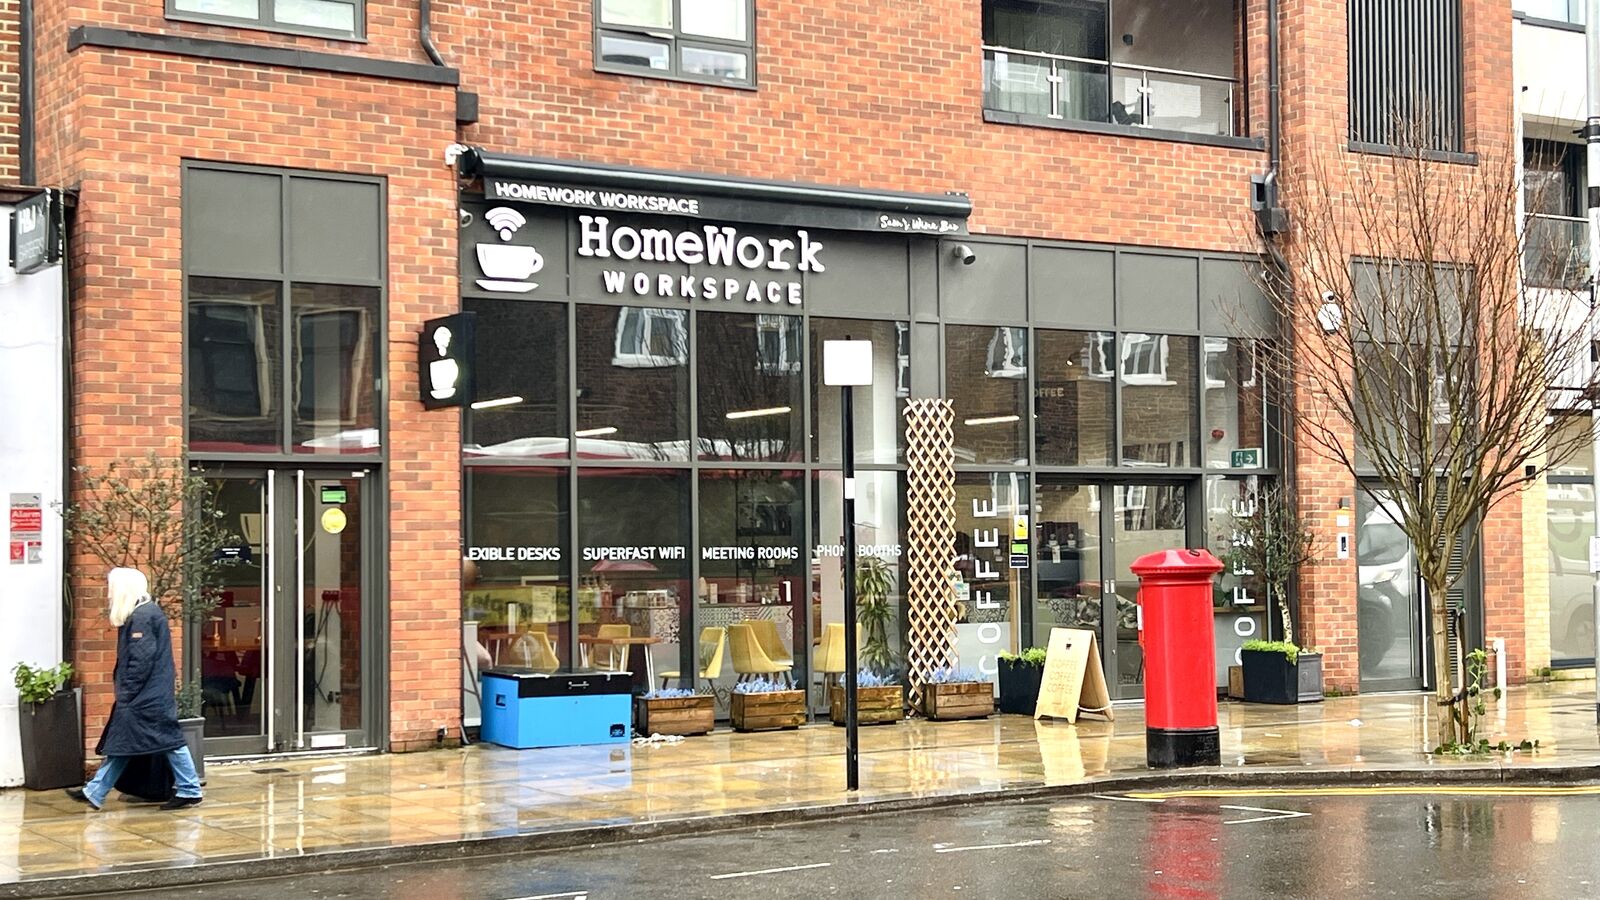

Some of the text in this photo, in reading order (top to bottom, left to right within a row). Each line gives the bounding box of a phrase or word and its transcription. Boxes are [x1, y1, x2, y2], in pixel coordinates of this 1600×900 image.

[494, 181, 699, 215] HOMEWORK WORKSPACE
[911, 217, 938, 230] Wine
[939, 220, 959, 232] Bar
[578, 215, 826, 273] HomeWork
[602, 270, 802, 305] WORKSPACE
[1034, 387, 1064, 397] OFFEE
[517, 547, 561, 560] DESKS
[583, 546, 686, 560] SUPERFAST WIFI
[702, 546, 799, 560] MEETING ROOMS
[816, 544, 902, 557] PHON BOOTHS
[973, 498, 1001, 675] COFFEE
